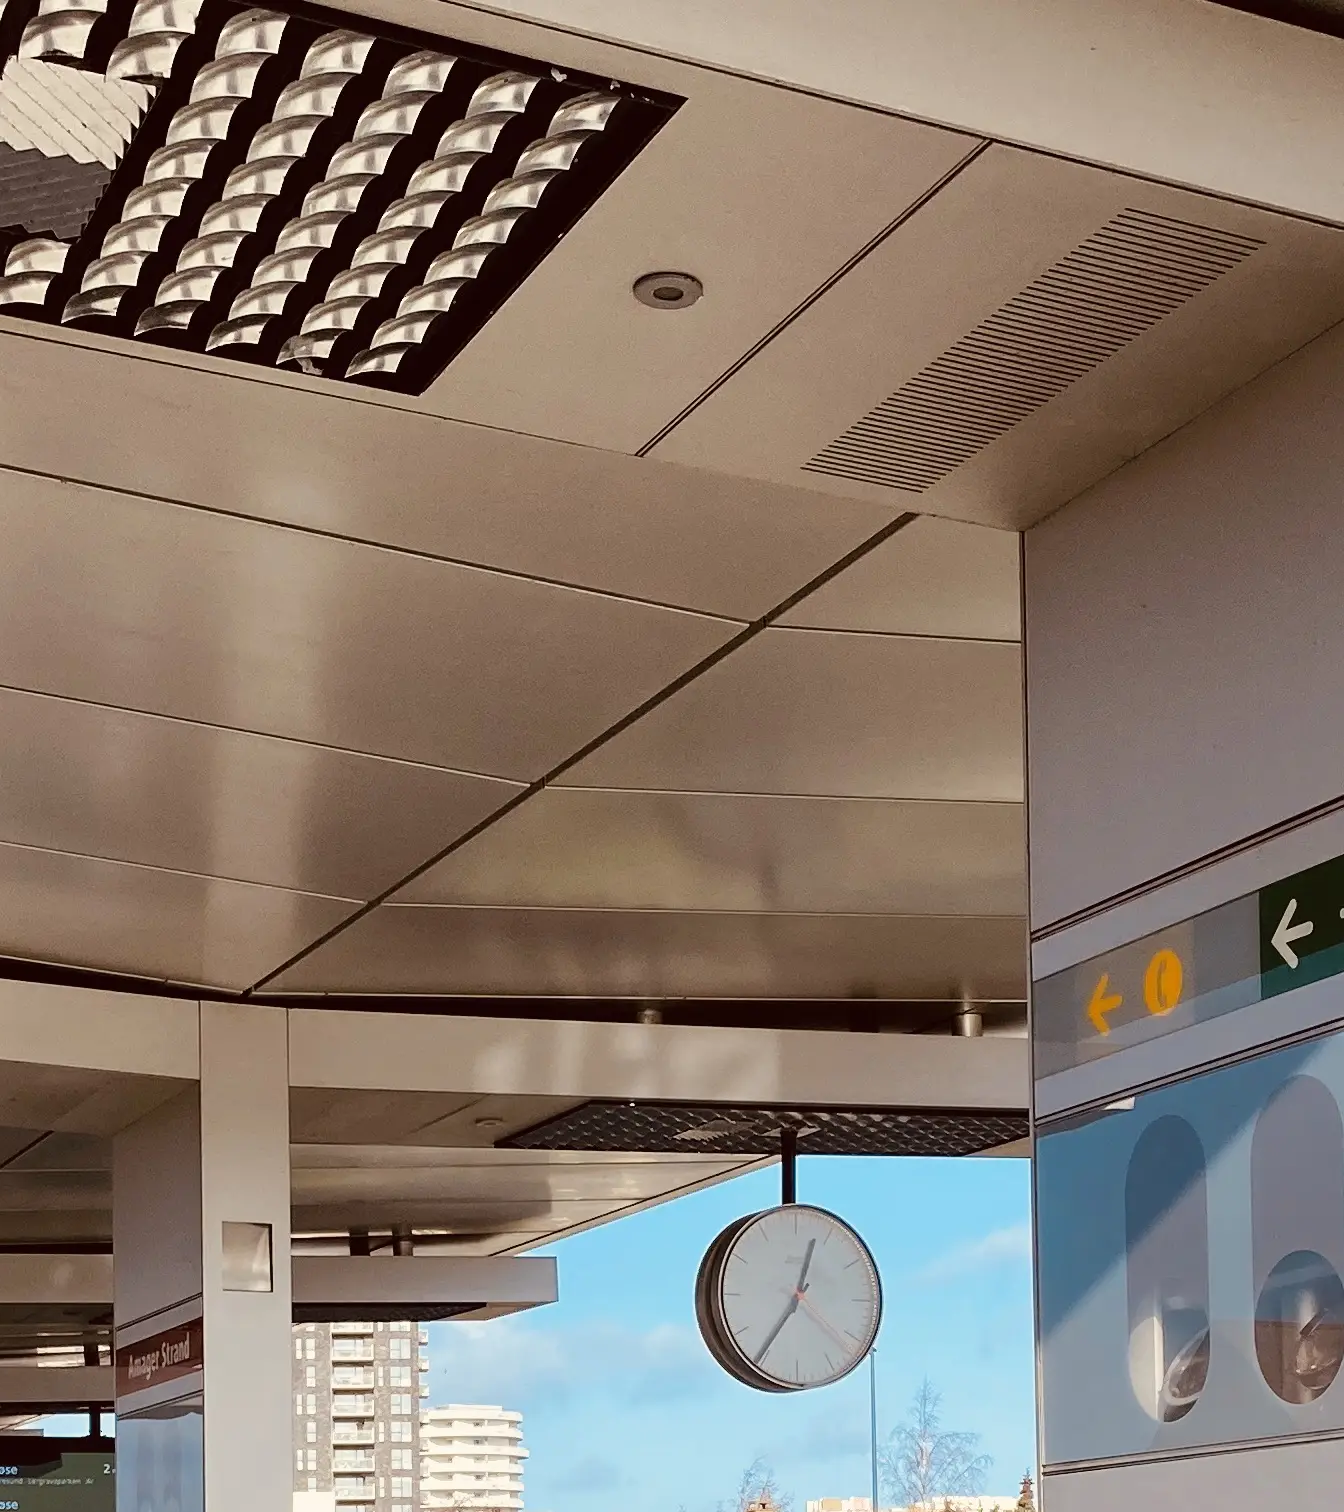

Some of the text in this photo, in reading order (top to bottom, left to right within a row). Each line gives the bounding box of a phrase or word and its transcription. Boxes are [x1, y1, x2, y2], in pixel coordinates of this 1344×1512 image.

[128, 1332, 190, 1380] Amager Strand
[103, 1463, 111, 1474] 2
